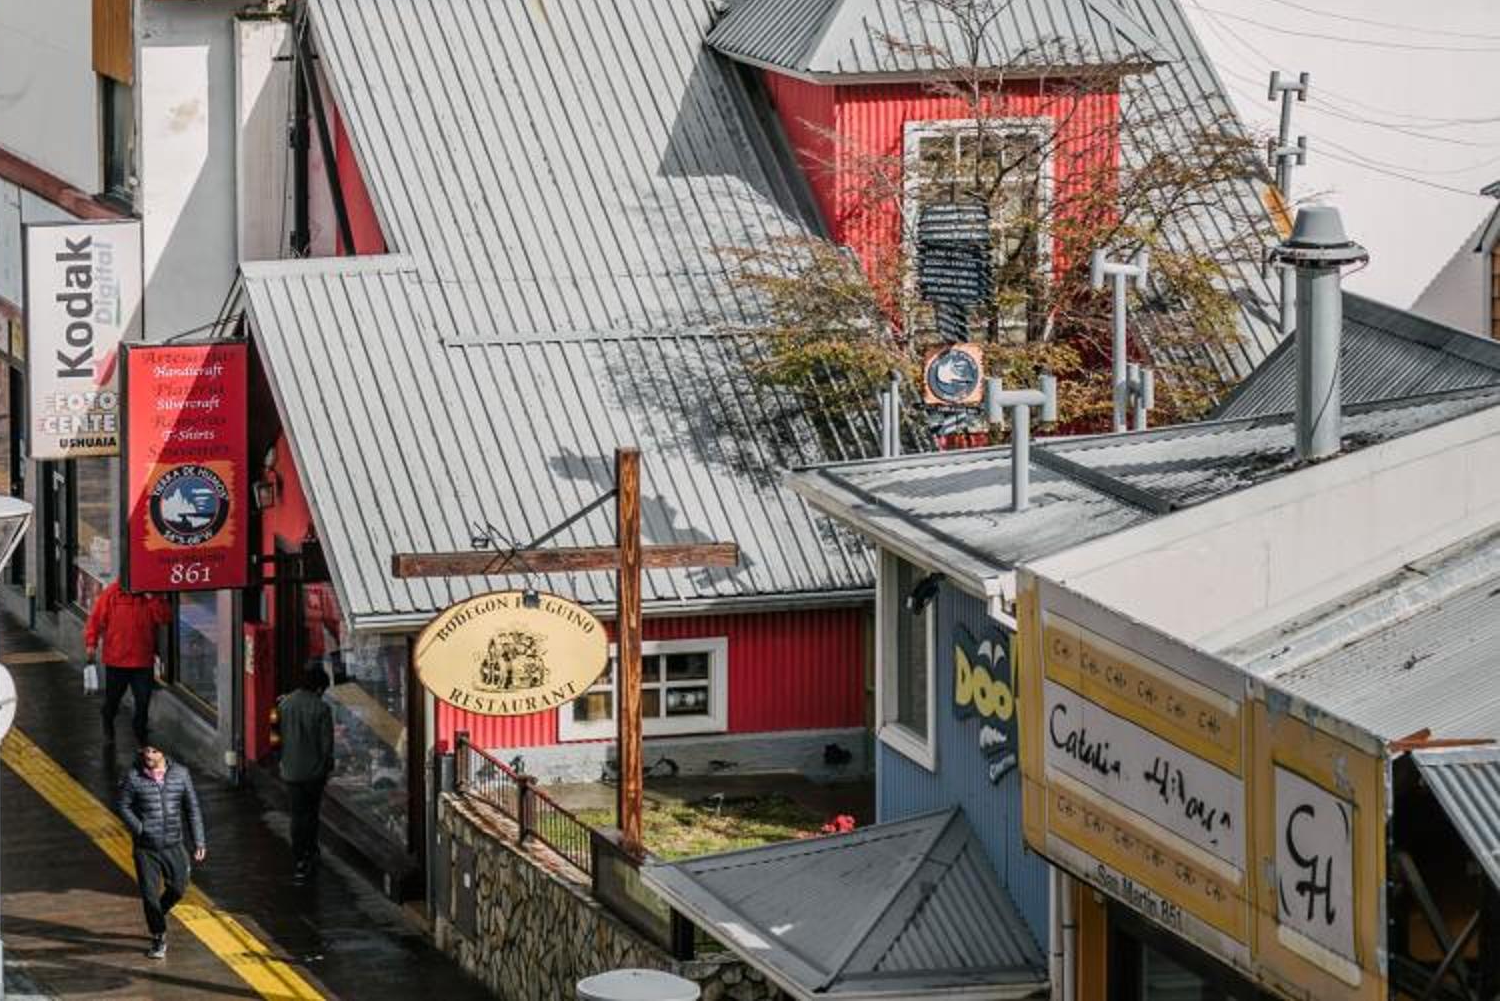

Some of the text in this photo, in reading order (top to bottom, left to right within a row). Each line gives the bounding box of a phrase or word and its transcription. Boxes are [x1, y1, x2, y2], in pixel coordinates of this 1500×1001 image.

[55, 235, 94, 378] Kodak
[44, 414, 117, 434] CENTE
[59, 436, 117, 448] USHUAIA
[170, 562, 212, 584] 861
[516, 596, 596, 635] GUINO
[448, 680, 577, 713] RESTAURANT
